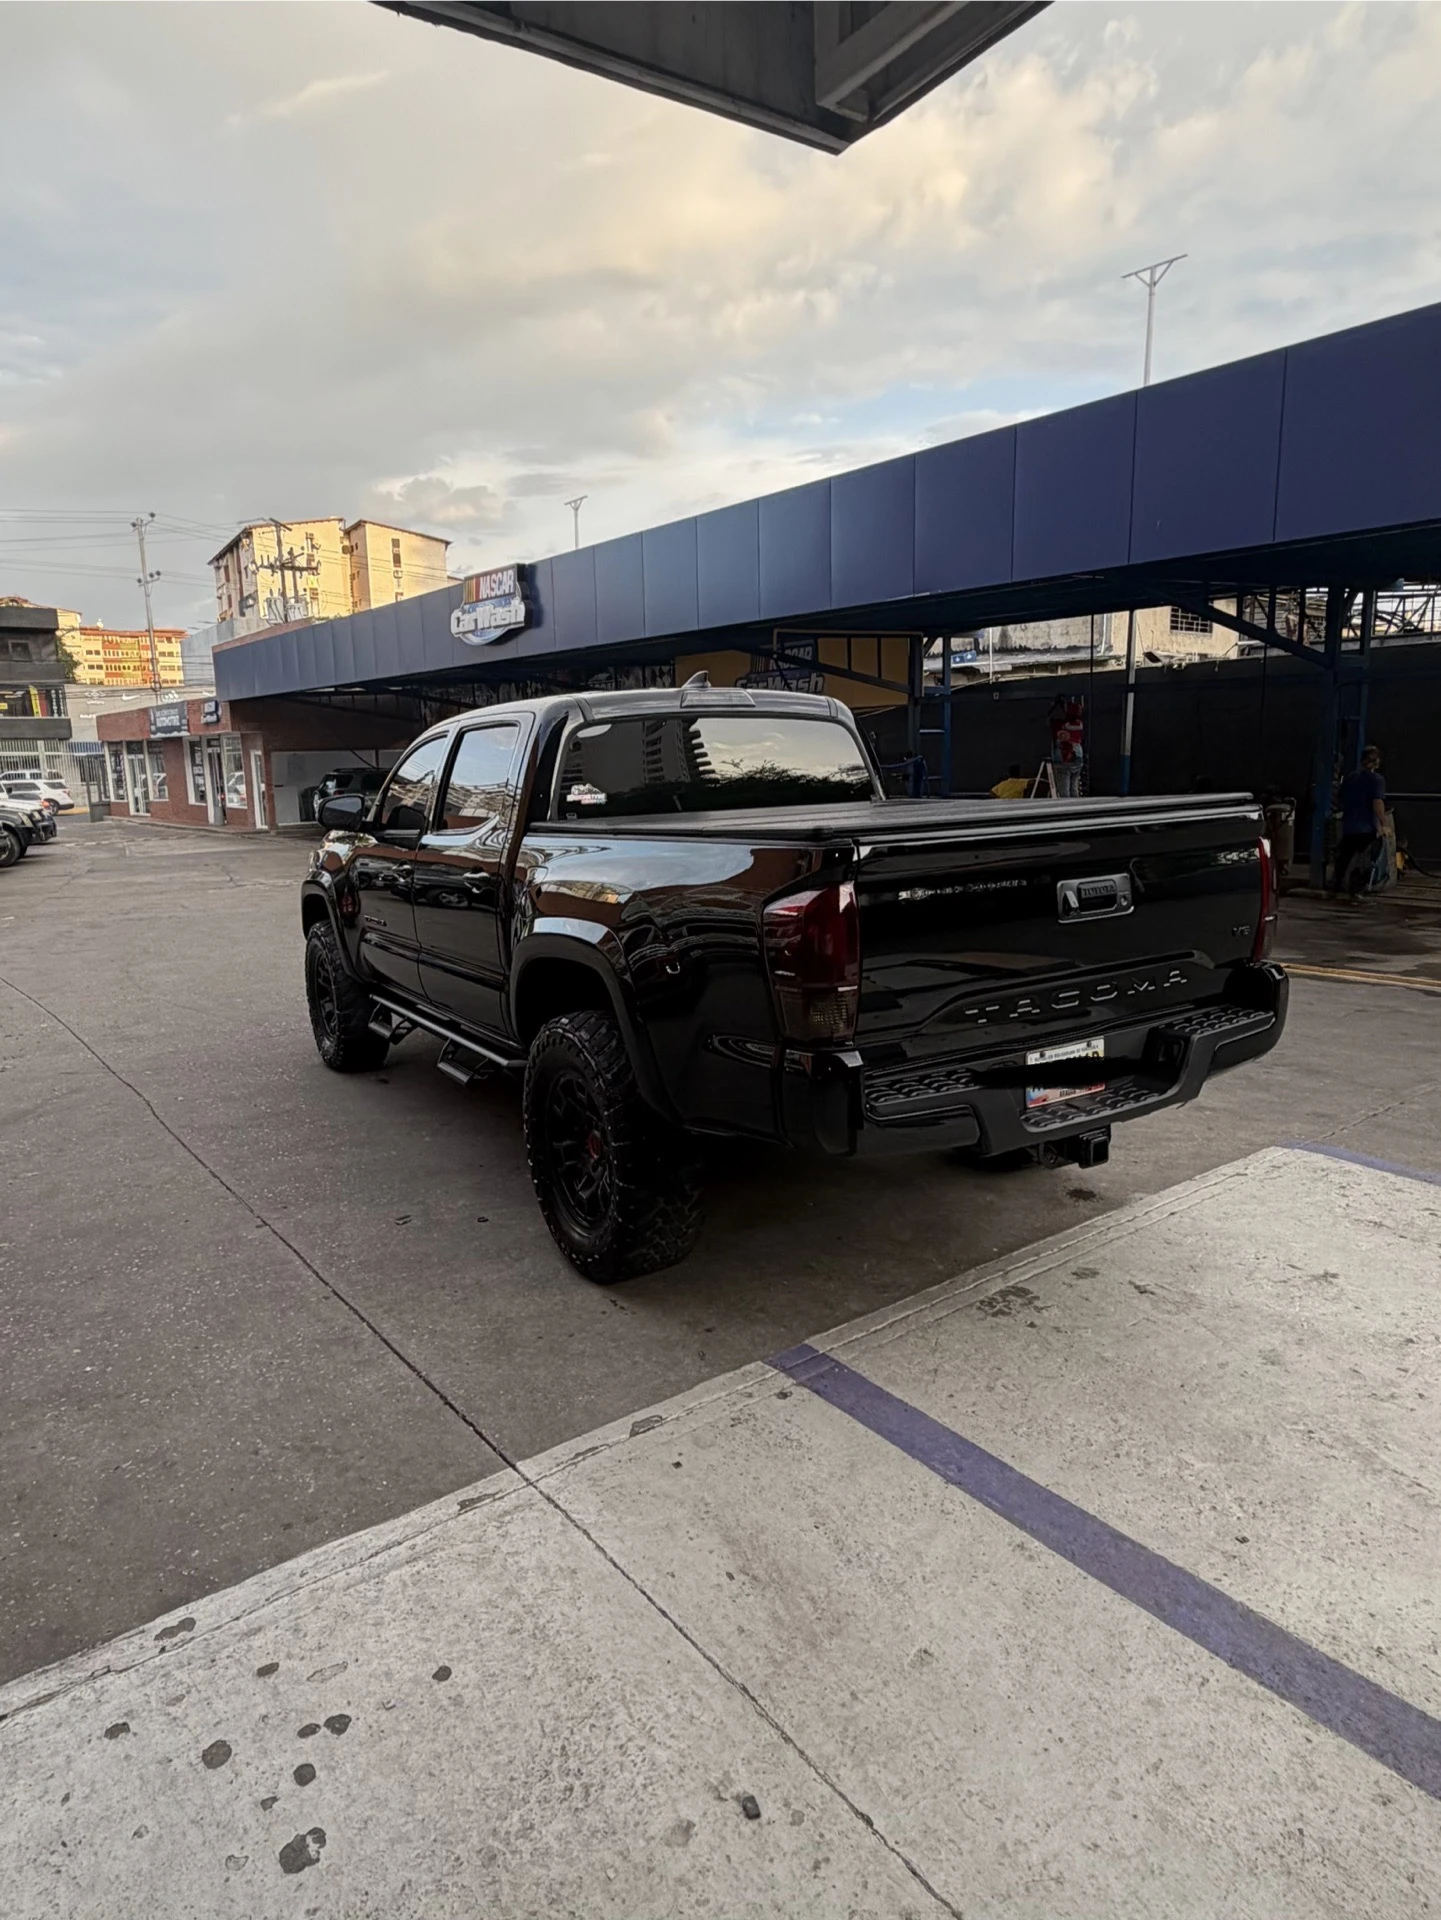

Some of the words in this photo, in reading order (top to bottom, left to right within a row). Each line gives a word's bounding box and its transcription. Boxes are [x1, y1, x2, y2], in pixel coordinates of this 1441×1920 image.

[480, 569, 515, 600] NASCAR
[1082, 884, 1116, 897] TOYOTA
[965, 970, 1188, 1023] TACOMA
